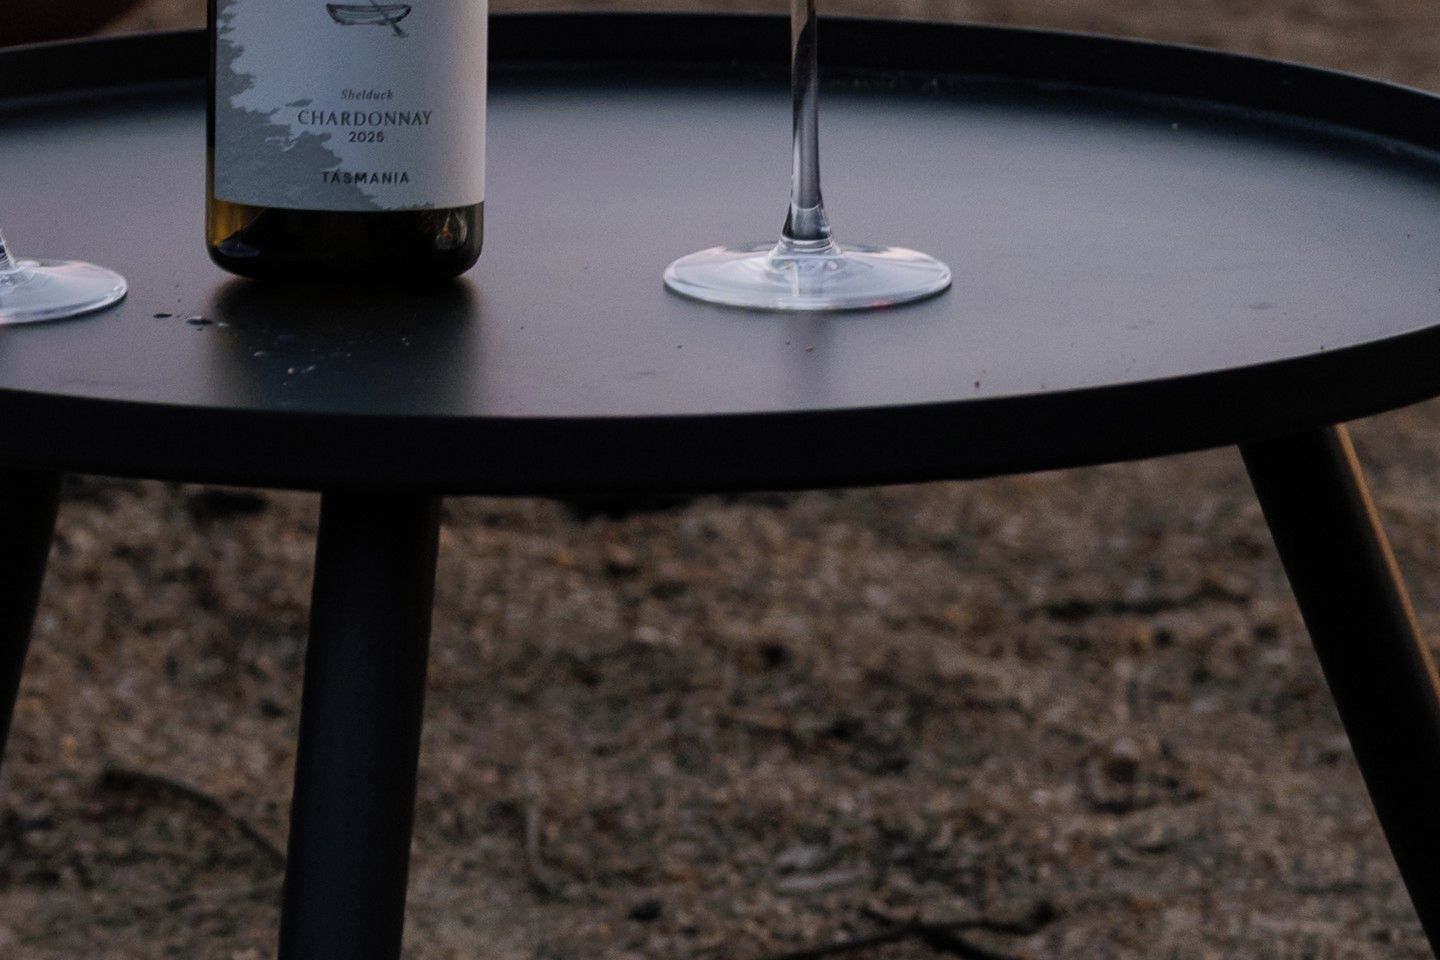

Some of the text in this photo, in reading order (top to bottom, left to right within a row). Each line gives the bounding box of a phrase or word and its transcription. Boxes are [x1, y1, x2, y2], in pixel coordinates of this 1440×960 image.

[340, 89, 394, 101] Shelduck
[297, 110, 433, 127] CHARDONNAY
[321, 170, 410, 185] TASMANIA
